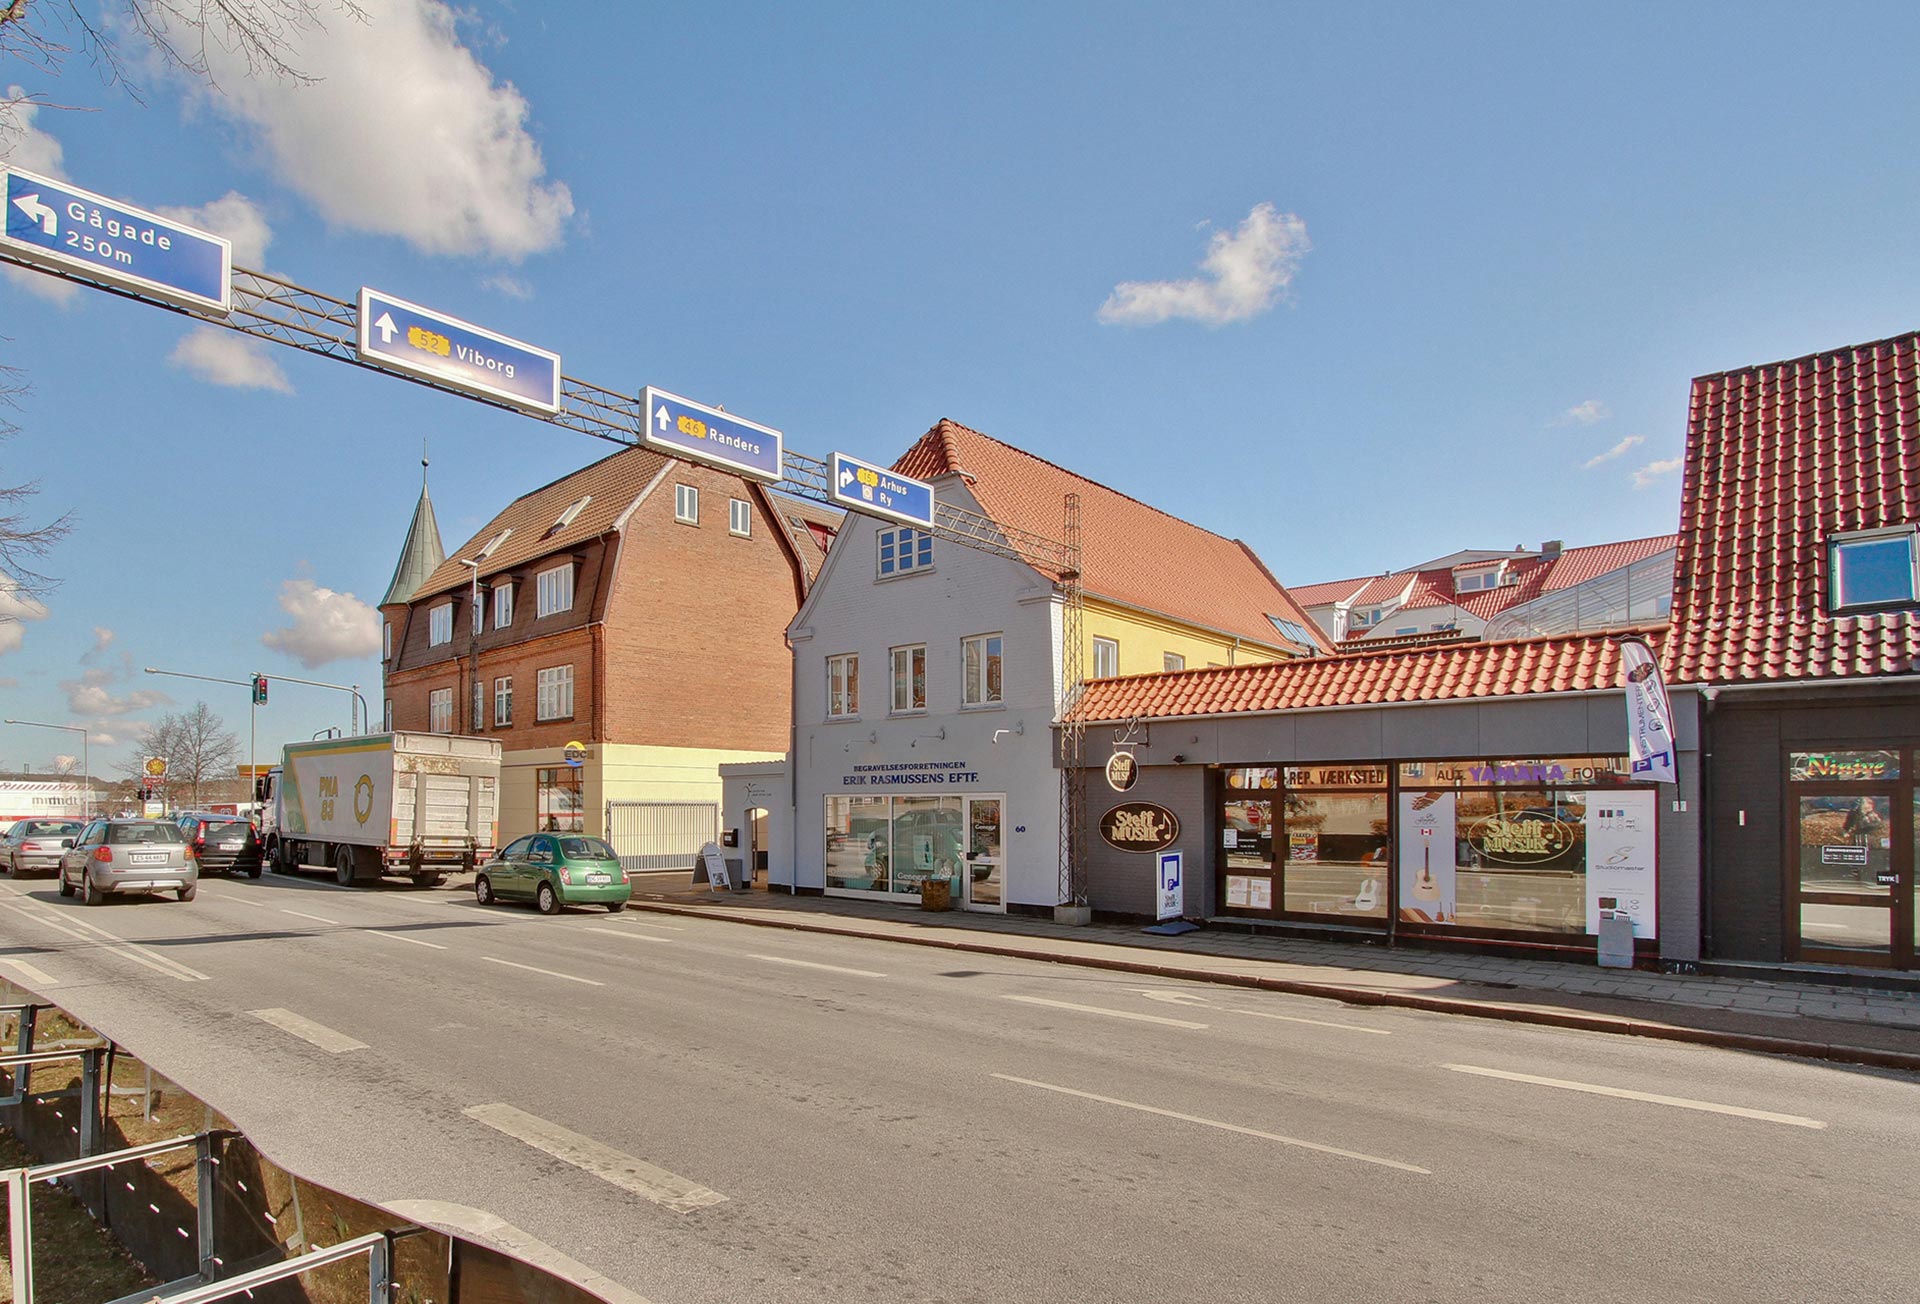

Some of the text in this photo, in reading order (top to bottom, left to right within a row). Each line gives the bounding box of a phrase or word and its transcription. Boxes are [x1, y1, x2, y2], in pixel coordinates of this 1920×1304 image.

[67, 201, 173, 251] Gågade
[66, 230, 133, 265] 250m
[419, 333, 515, 378] 52 Viborg
[684, 421, 760, 455] 46 Randers
[880, 492, 892, 507] Ry
[564, 750, 587, 759] EDC
[853, 761, 966, 772] BEGRAVELSESFORRETNINGEN
[1436, 769, 1466, 781] AUT.
[1469, 765, 1565, 782] YAMAHA
[1636, 761, 1648, 771] P
[843, 772, 979, 785] ERIK RASMUSSENS EFTF.
[1289, 769, 1385, 785] REP. VÆRKSTED
[1115, 810, 1155, 827] Steff
[1111, 825, 1160, 842] MUSIK
[1487, 819, 1546, 838] Steff
[1482, 836, 1551, 854] MUSIK
